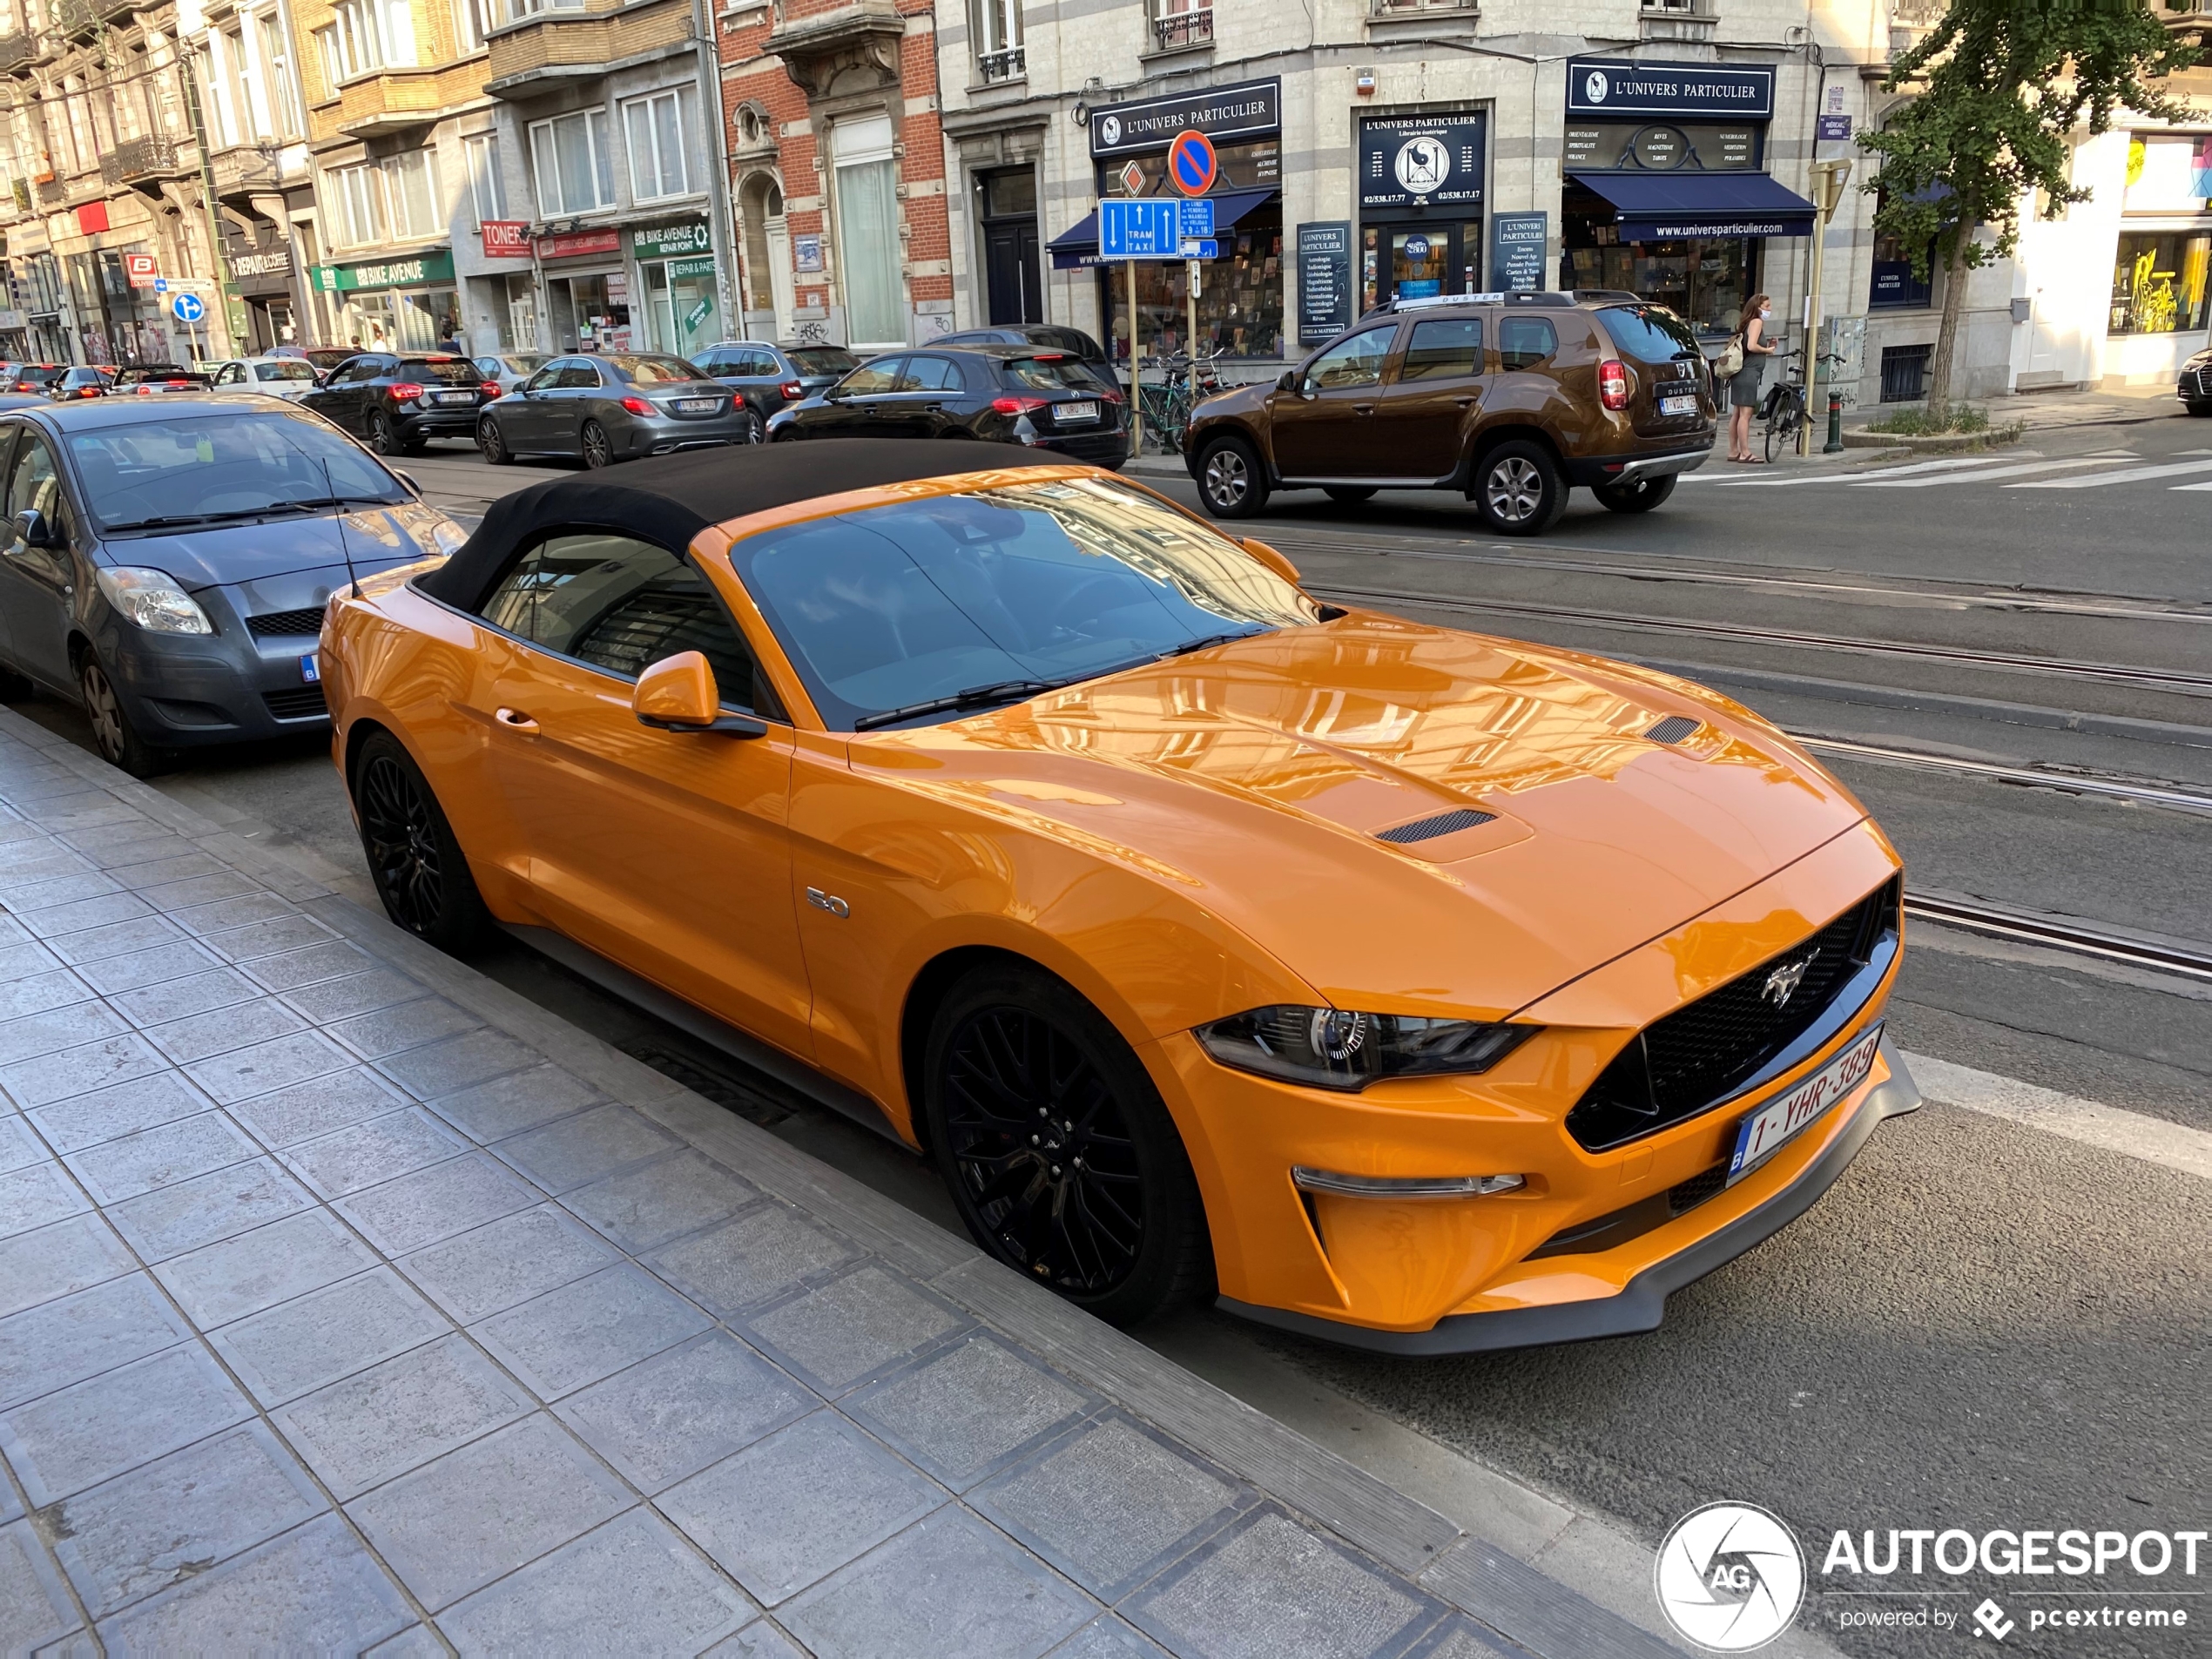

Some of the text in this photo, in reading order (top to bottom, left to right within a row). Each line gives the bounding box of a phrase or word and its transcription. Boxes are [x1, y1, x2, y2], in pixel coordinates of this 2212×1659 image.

[1615, 81, 1756, 98] L'UNIVERS PARTICULIER
[1127, 101, 1266, 133] L'UNIVERS PARTICULIER
[1366, 116, 1476, 130] L'UNIVERS PARTICULIER
[1364, 194, 1406, 203] 02/538.17.77
[1438, 190, 1480, 199] 02/538.17.17
[646, 226, 692, 243] BIKE AVENUE
[1128, 231, 1152, 239] TRAM
[1656, 223, 1782, 236] www.universparticulier.com
[660, 241, 693, 253] REPAIR POINT
[1128, 243, 1152, 251] TAXI
[236, 254, 265, 276] REPAIR
[268, 252, 288, 268] COFFEE
[676, 264, 694, 274] REPAIR
[695, 263, 699, 272] &
[700, 261, 716, 272] PARTS
[367, 260, 424, 285] BIKE AVENUE
[1443, 294, 1500, 303] DUSTER
[1668, 386, 1696, 395] DUSTER
[1059, 403, 1093, 414] 1-URU-715
[807, 886, 849, 918] 5.0
[1754, 1038, 1875, 1153] 1-YHR-389
[1730, 1152, 1742, 1170] B
